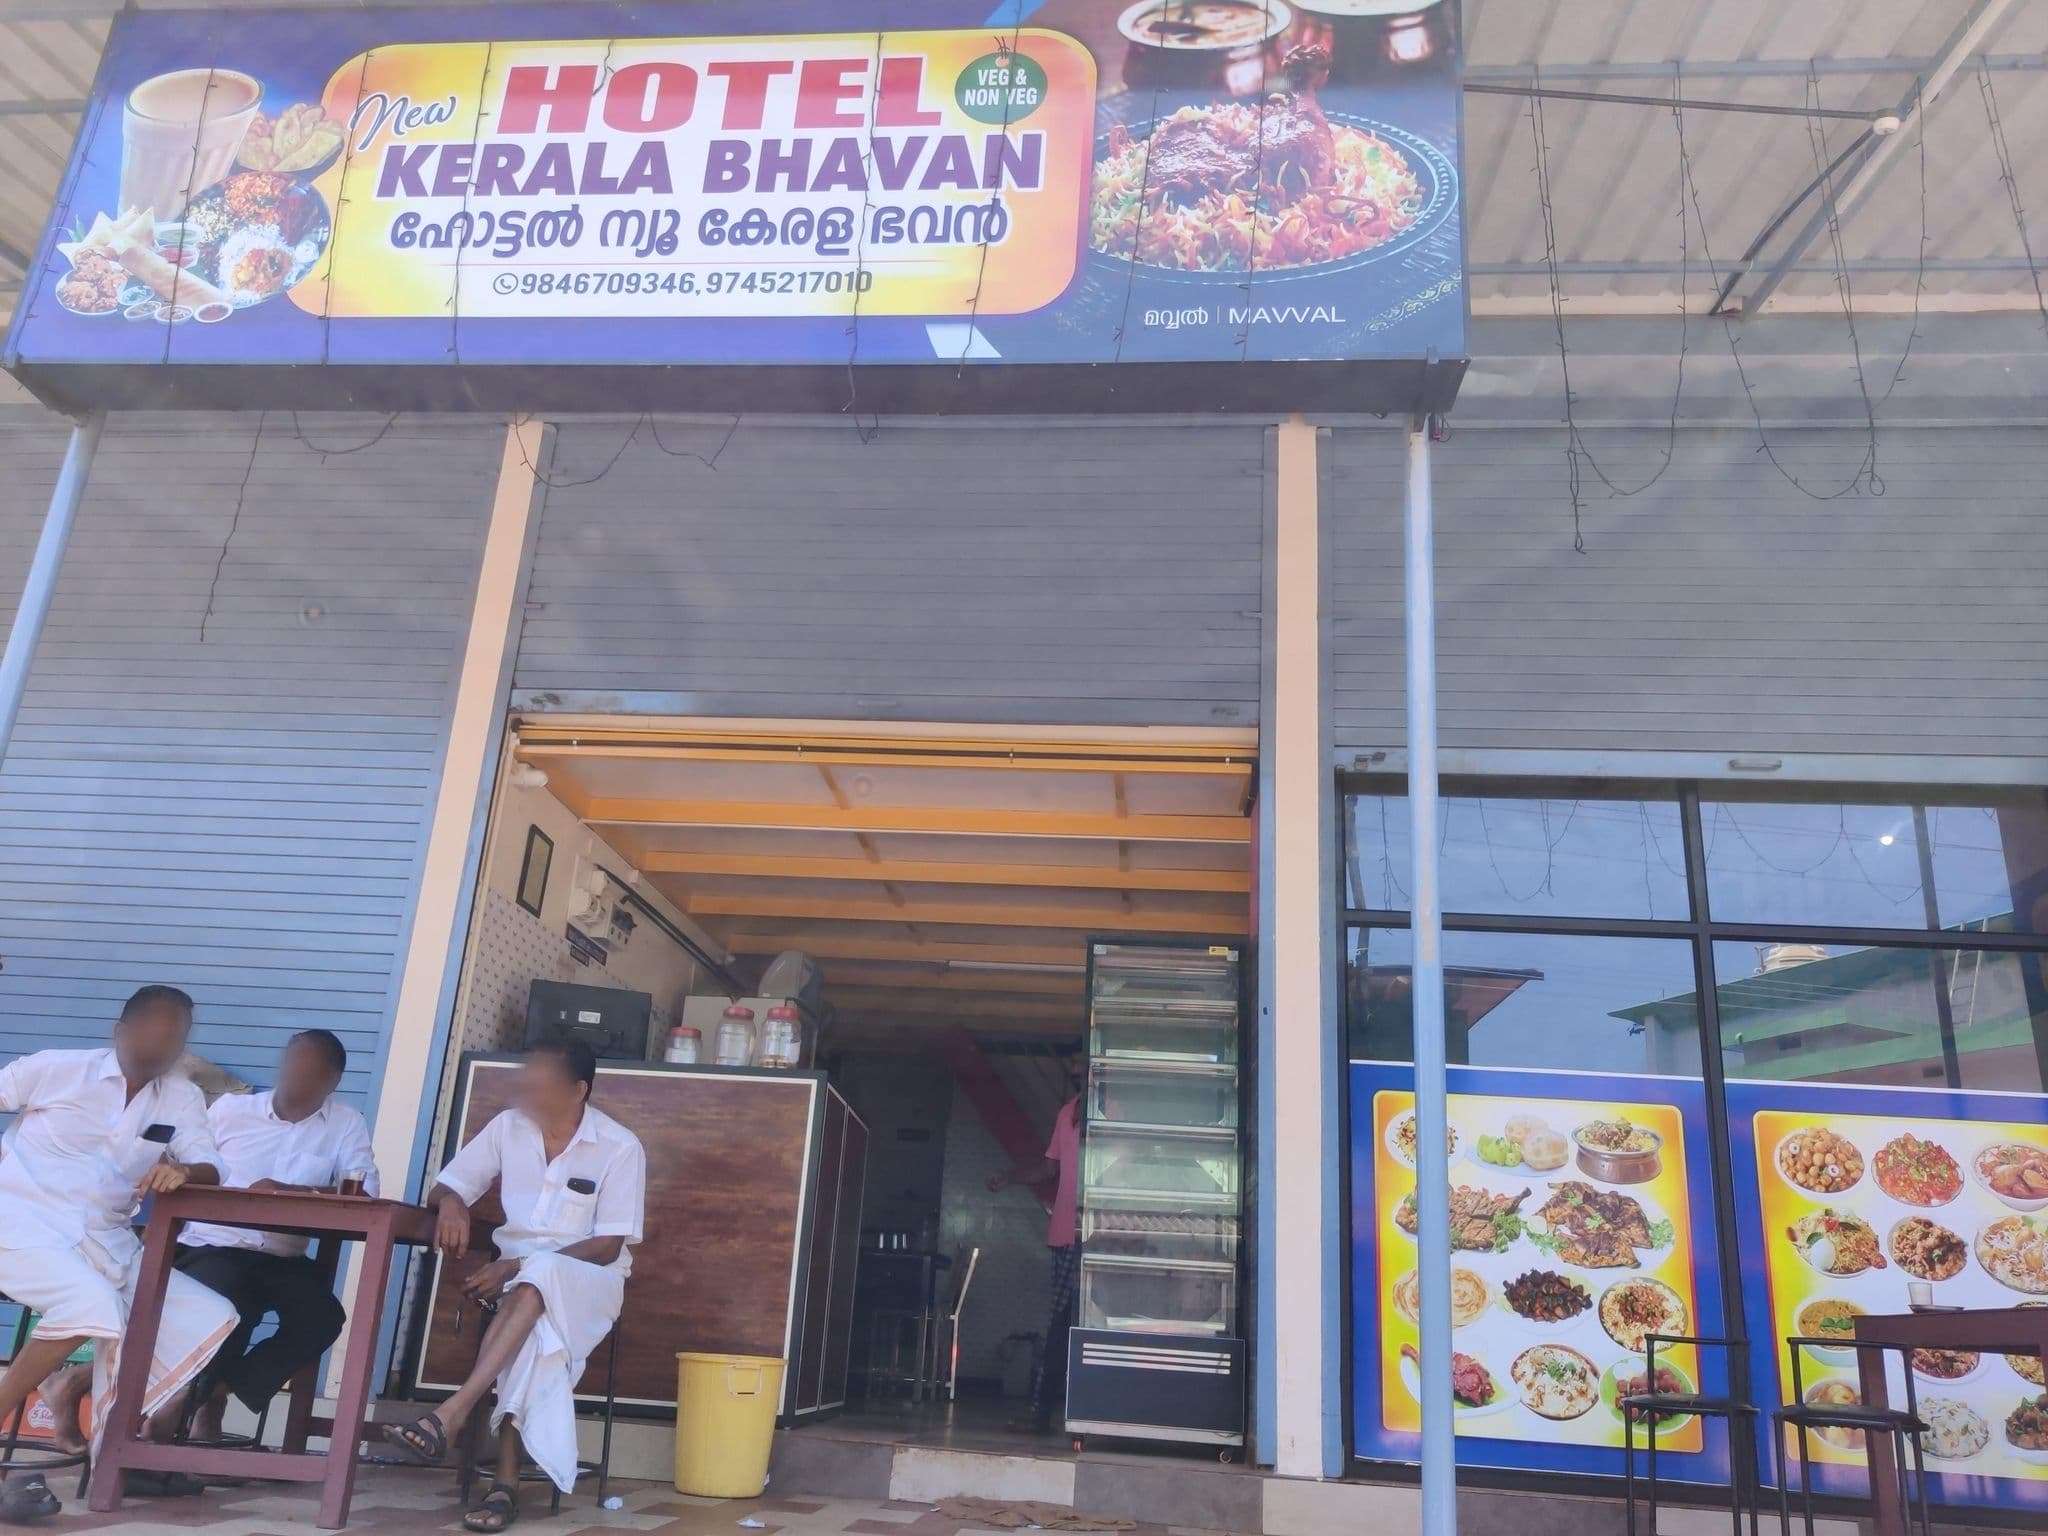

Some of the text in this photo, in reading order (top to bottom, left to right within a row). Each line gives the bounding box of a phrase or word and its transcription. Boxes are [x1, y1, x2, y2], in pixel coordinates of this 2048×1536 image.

[496, 56, 942, 134] HOTEL
[964, 87, 1038, 106] NON VEG
[977, 68, 1027, 86] VEG &
[348, 93, 458, 152] New
[376, 133, 1043, 198] KERALA BHAVAN
[391, 203, 584, 258] ഹോട്ടൽ
[698, 206, 855, 256] കേരള
[870, 198, 1009, 245] ഭവൻ
[1229, 307, 1346, 325] MAVVAL
